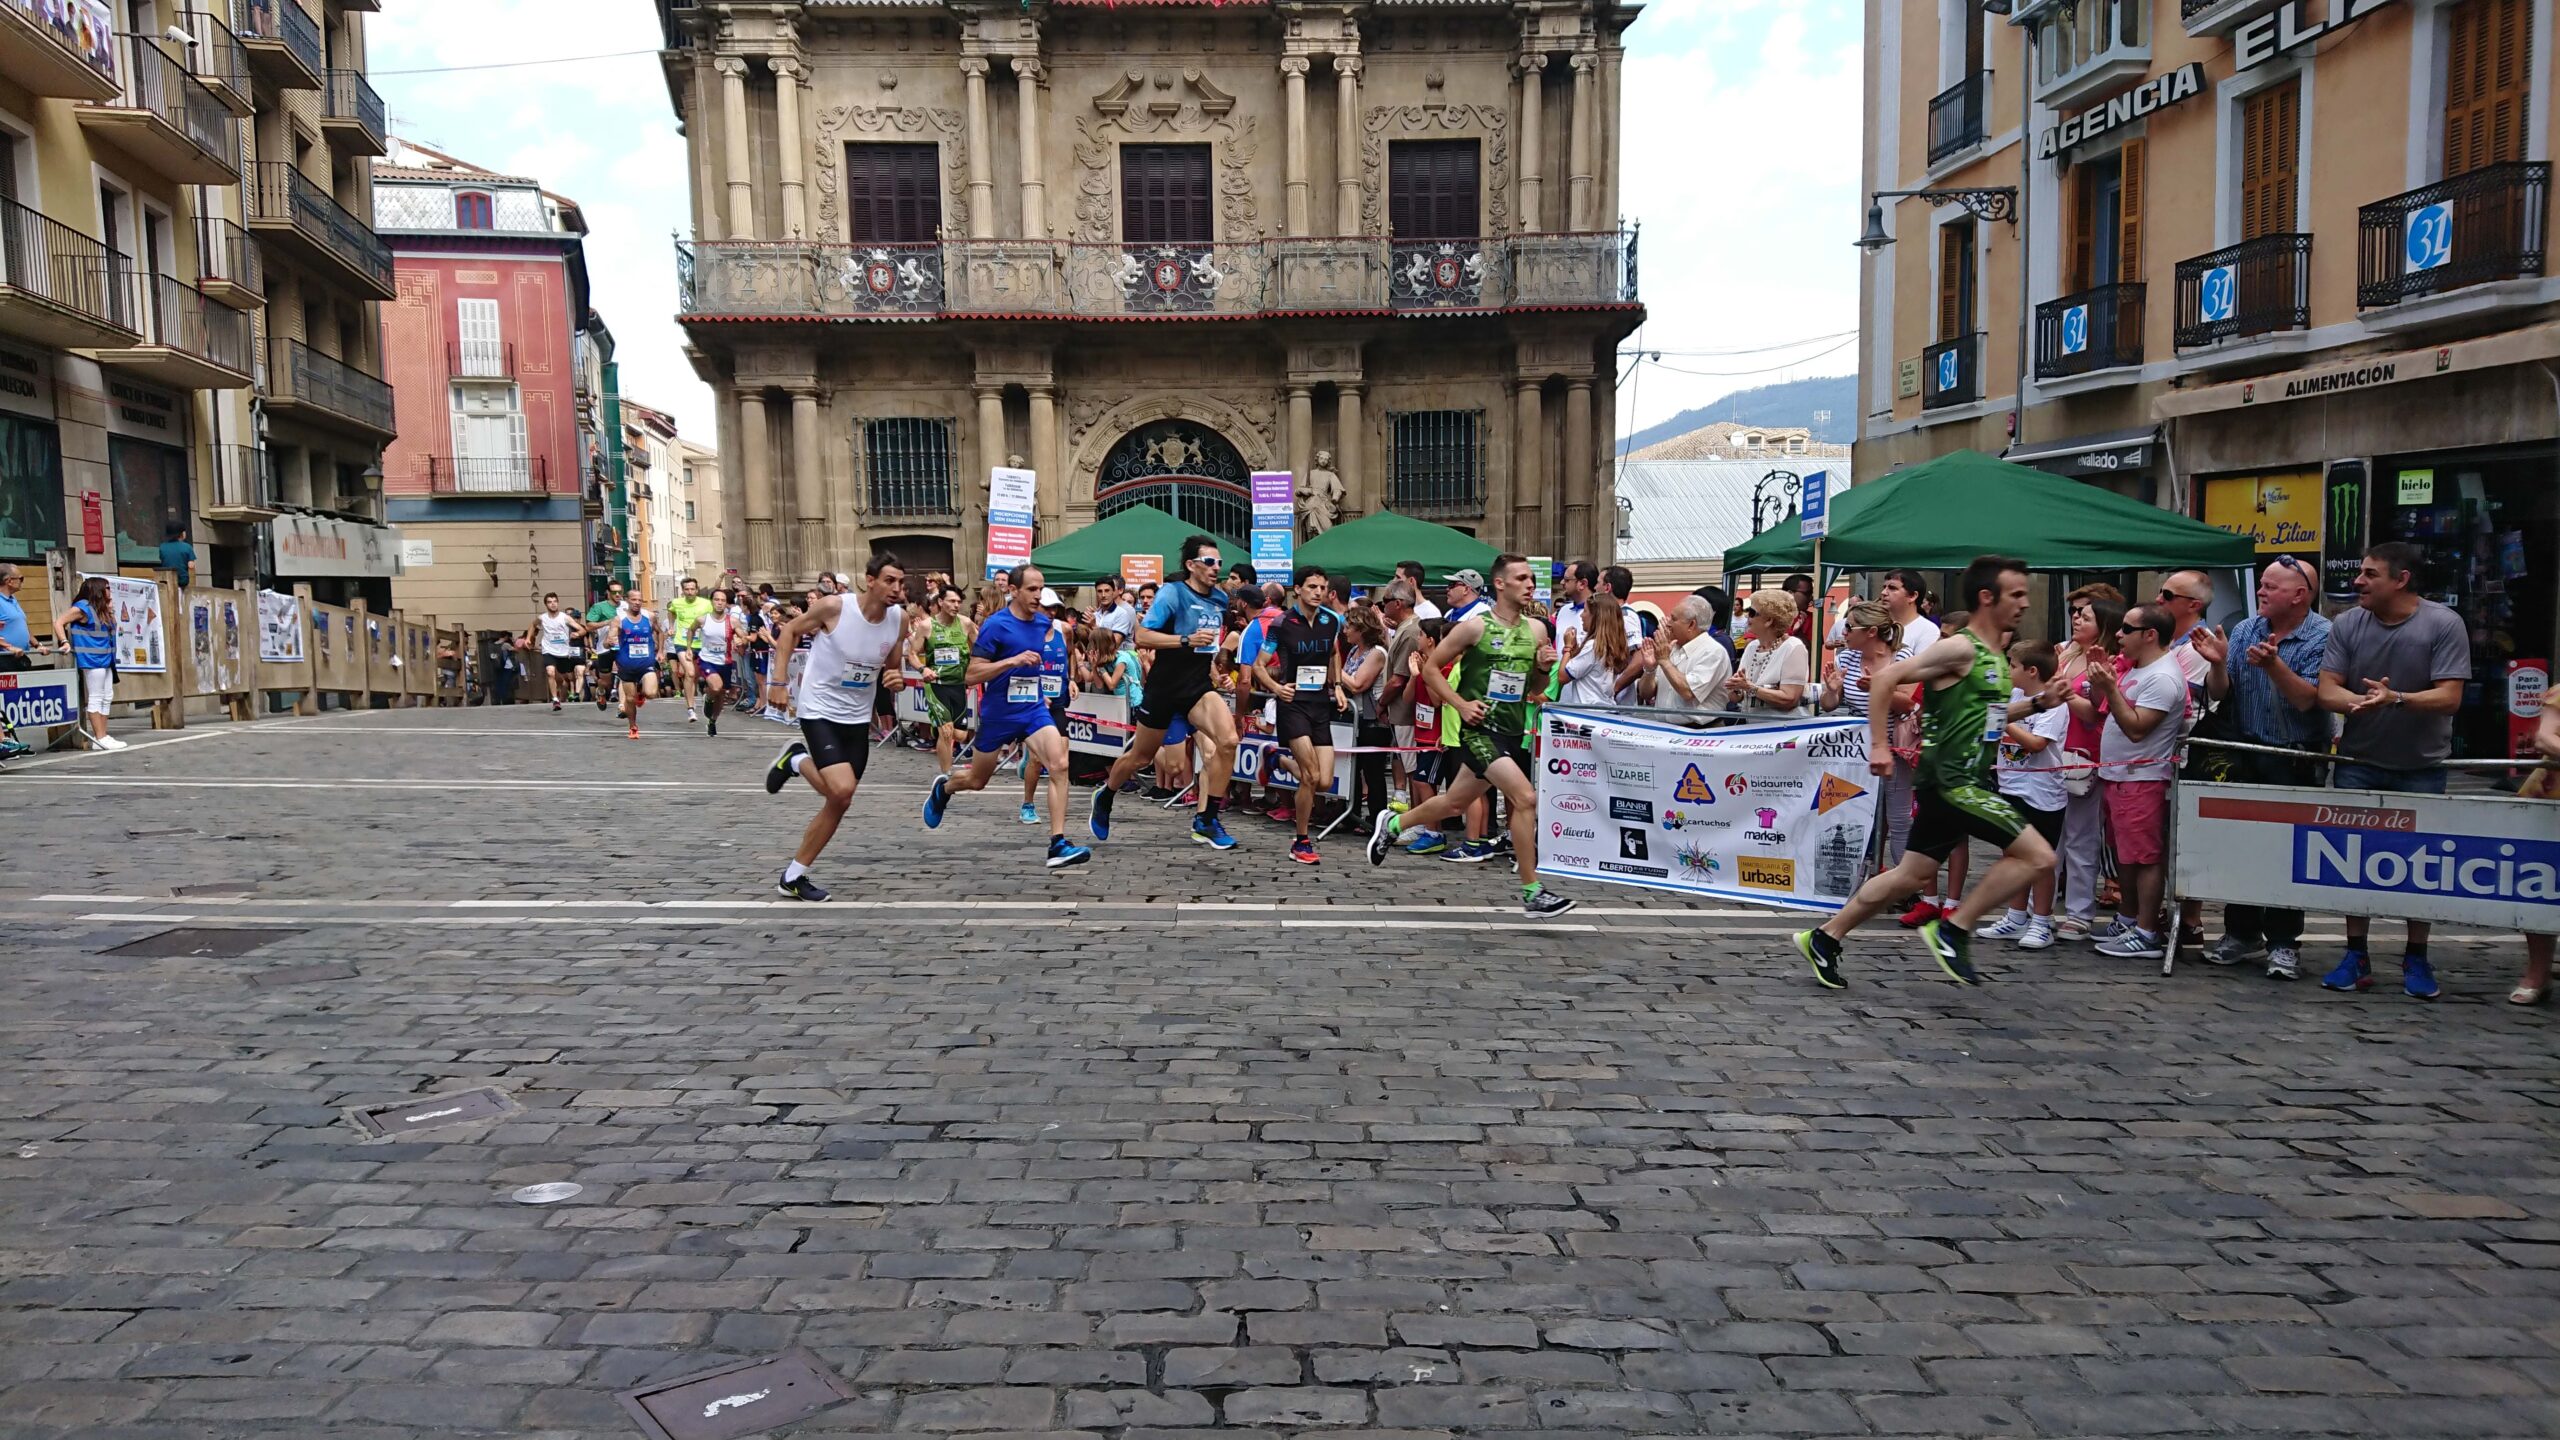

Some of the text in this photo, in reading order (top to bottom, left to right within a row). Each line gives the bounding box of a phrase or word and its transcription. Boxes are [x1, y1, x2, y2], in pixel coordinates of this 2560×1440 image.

[2037, 63, 2200, 160] AGENCIA
[2285, 361, 2396, 397] ALIMENTACIÓN
[2401, 478, 2431, 491] hielo
[2270, 521, 2319, 545] Lilian
[8, 675, 17, 688] de
[853, 672, 870, 682] 87
[1309, 675, 1315, 684] 1
[1017, 685, 1029, 695] 77
[1042, 683, 1055, 691] 88
[1500, 683, 1517, 695] 36
[2515, 683, 2541, 691] llevar
[2516, 691, 2541, 699] Take
[2515, 699, 2541, 707] away
[1808, 728, 1865, 746] IRUÑA
[1562, 738, 1592, 751] YAMAHA
[1807, 744, 1869, 763] ZARRA
[1572, 762, 1597, 771] canal
[1577, 769, 1597, 778] cero
[1609, 766, 1652, 783] LIZARBE
[1750, 779, 1803, 789] bidaurreta
[1558, 800, 1592, 811] AROMA
[1687, 819, 1731, 828] cartuchos
[2314, 805, 2411, 830] Diario de
[1562, 826, 1595, 839] divertis
[1744, 830, 1787, 845] markaje
[1600, 862, 1633, 873] ALBERTO
[1742, 868, 1791, 887] urbasa
